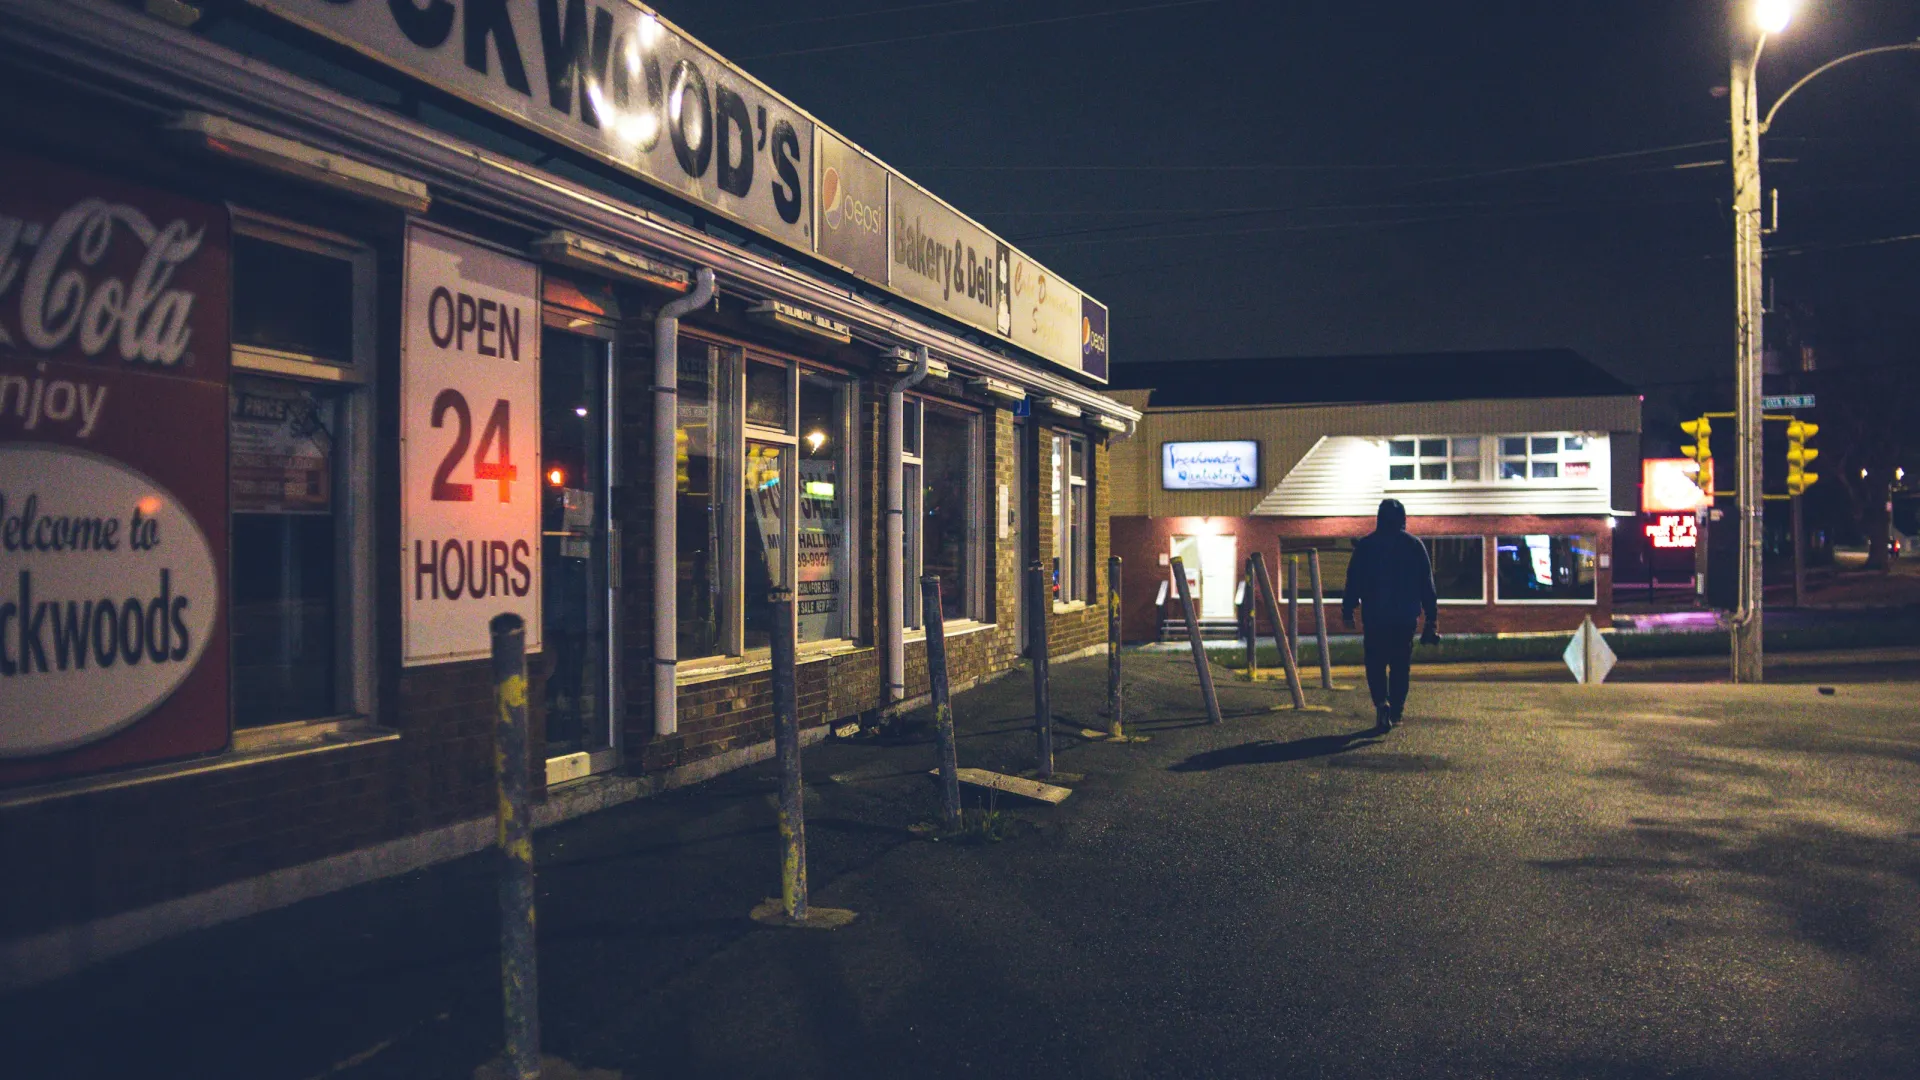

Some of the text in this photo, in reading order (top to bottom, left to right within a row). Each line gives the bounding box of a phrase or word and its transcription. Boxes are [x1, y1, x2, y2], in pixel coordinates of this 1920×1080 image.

[844, 194, 882, 236] pepsi
[893, 202, 952, 301] Bakery
[953, 238, 965, 294] &
[967, 245, 993, 308] Deli
[428, 286, 520, 362] OPEN
[1090, 330, 1105, 357] pepsi
[430, 388, 517, 504] 24
[0, 494, 160, 552] elcome to
[798, 533, 841, 549] HALLIDAY
[415, 538, 531, 600] HOURS
